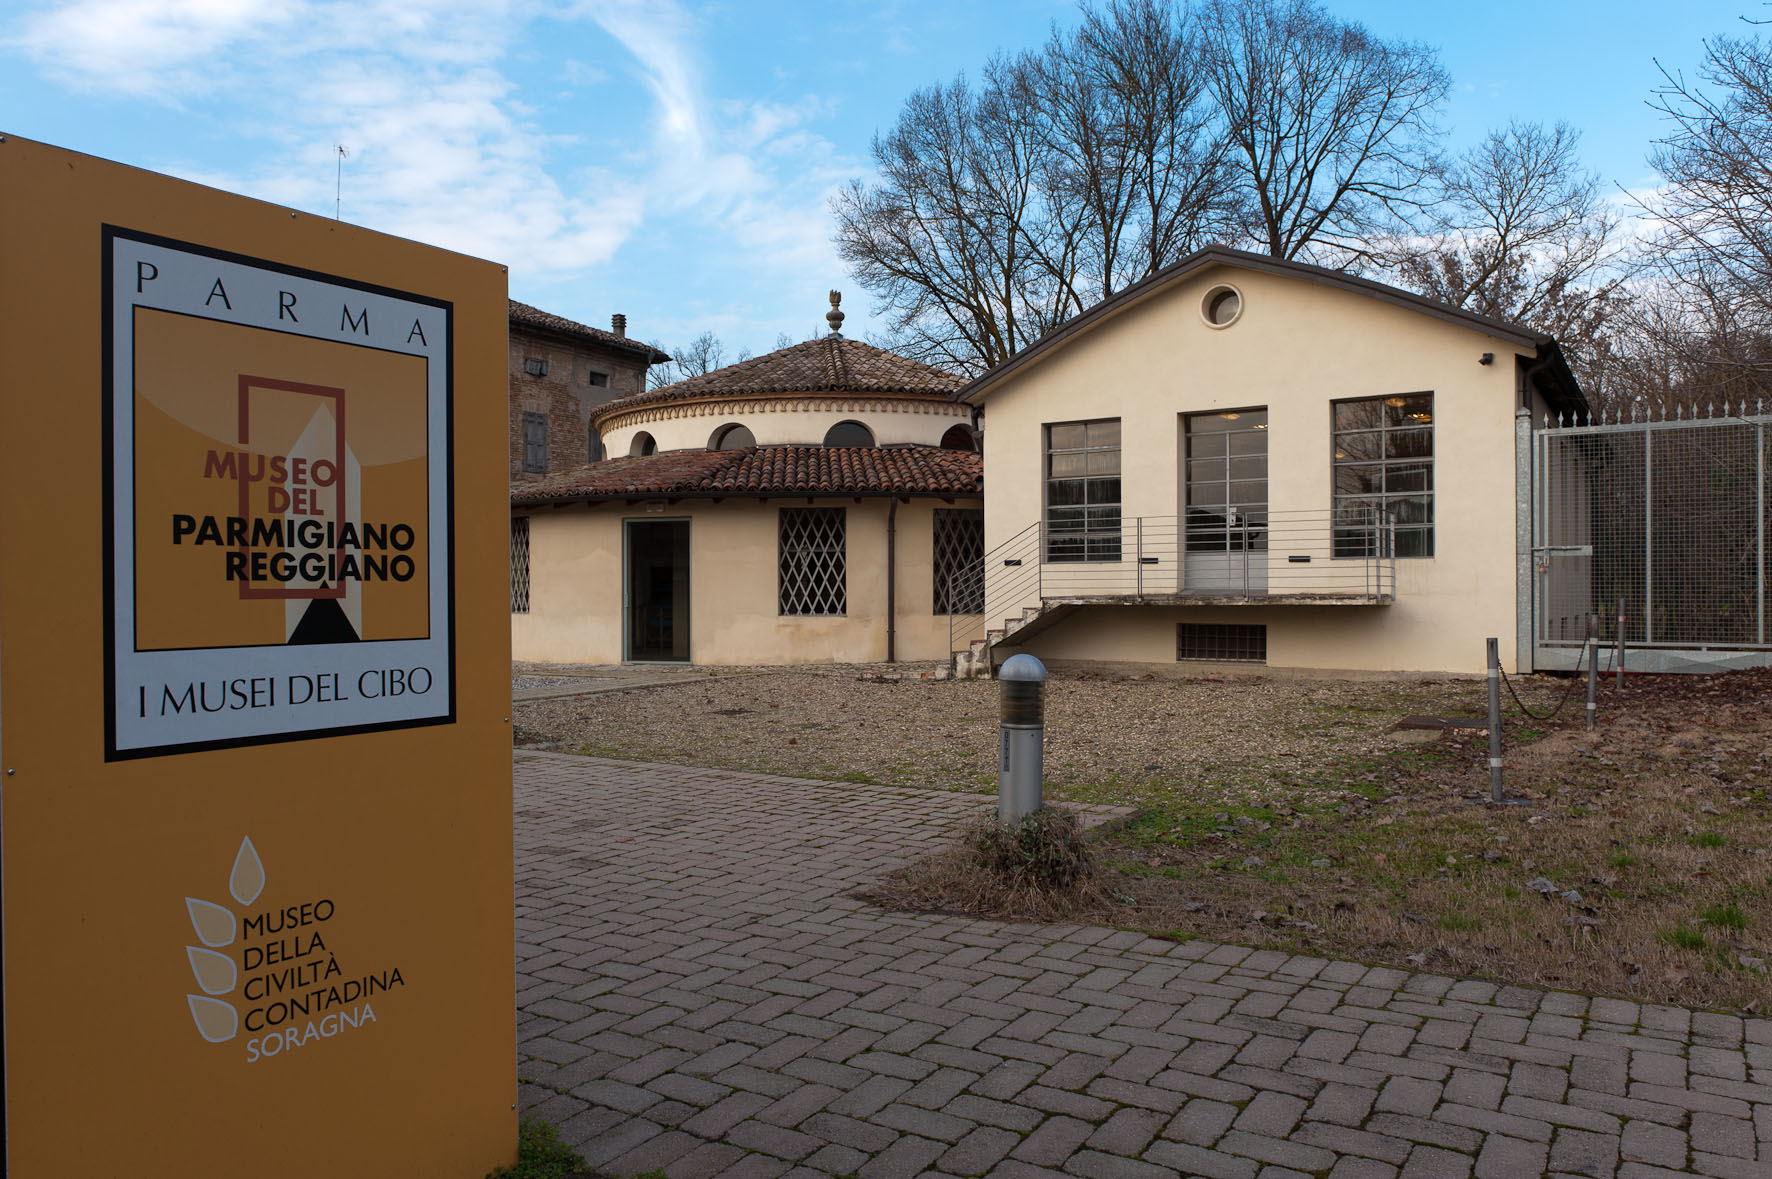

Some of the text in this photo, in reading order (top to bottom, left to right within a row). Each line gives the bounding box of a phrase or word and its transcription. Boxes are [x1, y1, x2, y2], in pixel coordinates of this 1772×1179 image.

[136, 261, 428, 346] PARMA
[203, 450, 337, 487] MUSEO
[268, 486, 324, 516] DEL
[173, 514, 415, 550] PARMIGIANO
[226, 552, 415, 582] REGGIANO
[139, 667, 433, 718] I MUSEI DEL CIBO
[243, 899, 335, 940] MUSEO
[244, 931, 326, 971] DELLA
[244, 952, 342, 1001] CIVILTÀ
[245, 967, 405, 1032] CONTADINA
[247, 1003, 377, 1063] SORAGNA
